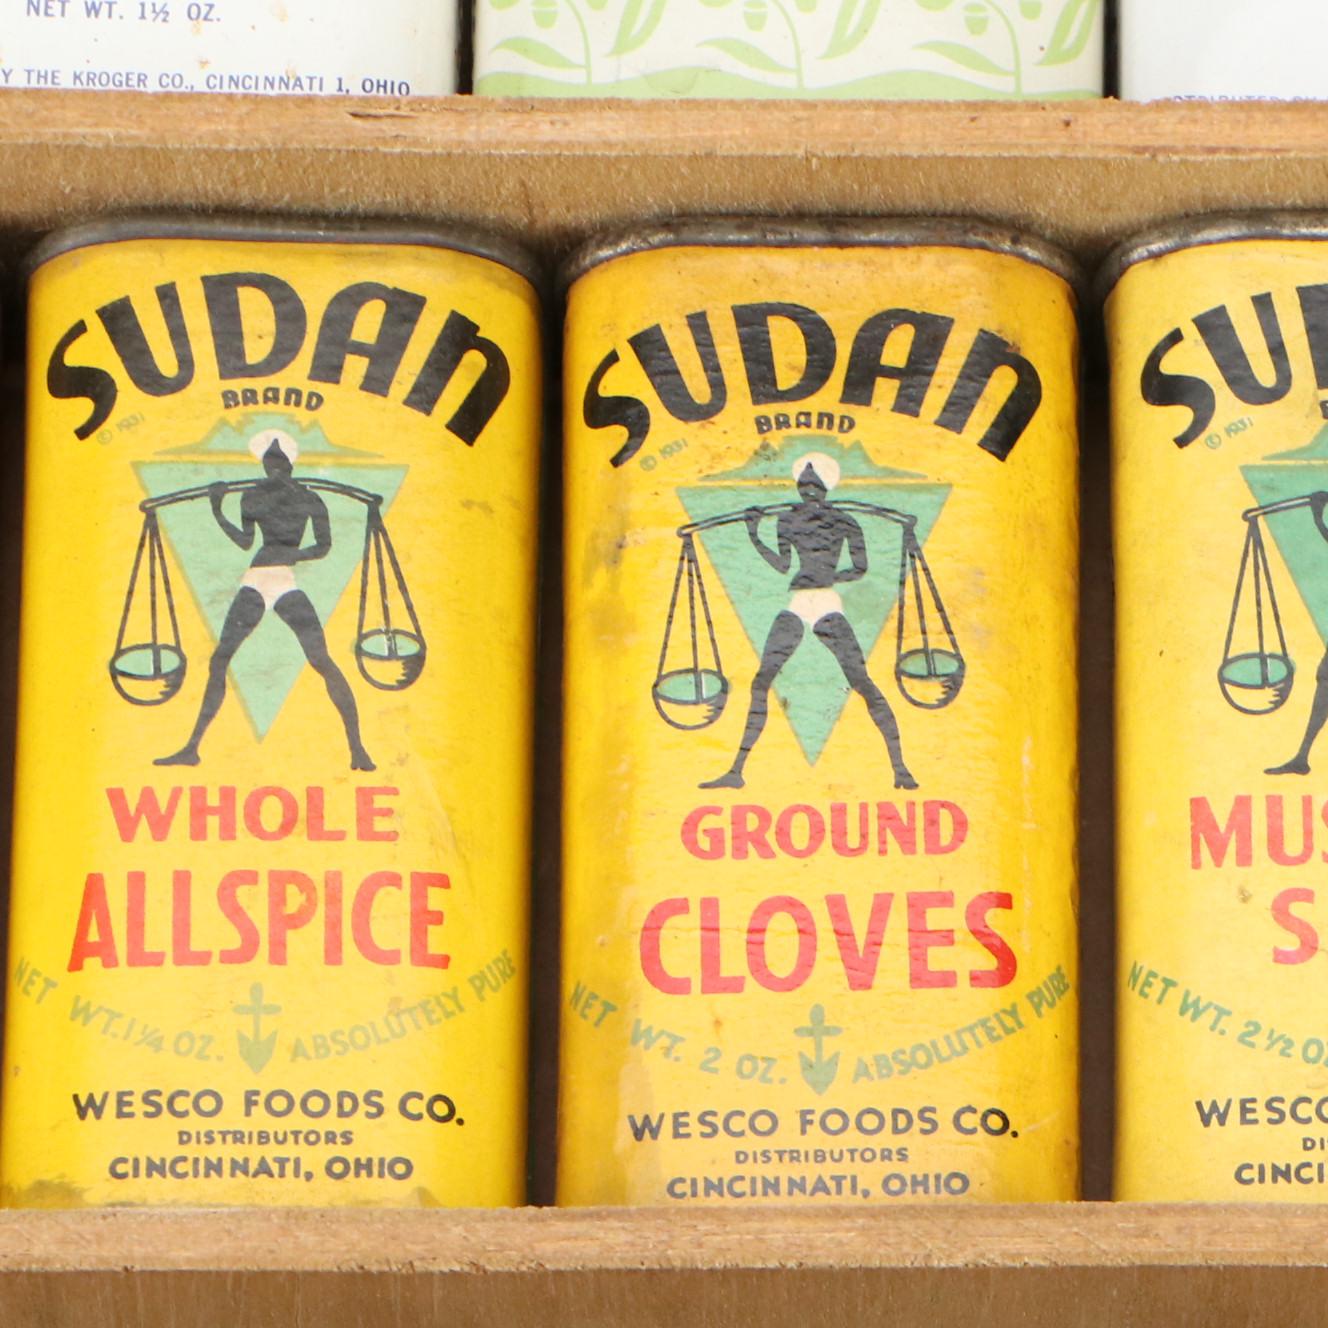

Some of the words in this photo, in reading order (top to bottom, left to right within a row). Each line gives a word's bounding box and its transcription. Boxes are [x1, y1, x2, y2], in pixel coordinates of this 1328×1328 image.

[26, 0, 70, 17] NET
[84, 1, 124, 20] WT.
[186, 4, 221, 21] OZ.
[25, 69, 61, 86] THE
[73, 70, 148, 89] KROGER
[158, 73, 195, 91] CO.,
[205, 73, 323, 93] CINCINNATI
[361, 78, 411, 96] OHIO
[47, 272, 510, 447] SUDAN
[222, 386, 325, 412] BRAND
[583, 302, 1043, 468] SUDAN
[754, 411, 856, 435] BRAND
[106, 786, 400, 843] WHOLE
[680, 800, 969, 861] GROUND
[67, 870, 451, 972] ALLSPICE
[640, 891, 1018, 995] CLOVES
[13, 957, 58, 1005] NET
[289, 986, 465, 1064] ABSOLUTELY
[468, 948, 517, 1004] PURE
[1127, 960, 1179, 1005] NET
[1179, 987, 1233, 1036] WT.
[570, 980, 618, 1028] NET
[699, 1047, 721, 1074] 2
[735, 1056, 787, 1085] OZ.
[852, 1002, 1025, 1084] ABSOLUTELY
[1026, 964, 1072, 1019] PURE
[72, 1089, 224, 1121] WESCO
[243, 1089, 385, 1118] FOODS
[397, 1091, 465, 1126] CO.
[627, 1108, 779, 1142] WESCO
[800, 1106, 939, 1136] FOODS
[952, 1105, 1018, 1138] CO.
[177, 1129, 354, 1147] DISTRIBUTORS
[735, 1147, 910, 1165] DISTRIBUTORS
[108, 1155, 314, 1182] CINCINNATI,
[324, 1155, 414, 1181] OHIO
[666, 1173, 872, 1200] CINCINNATI,
[882, 1171, 970, 1196] OHIO
